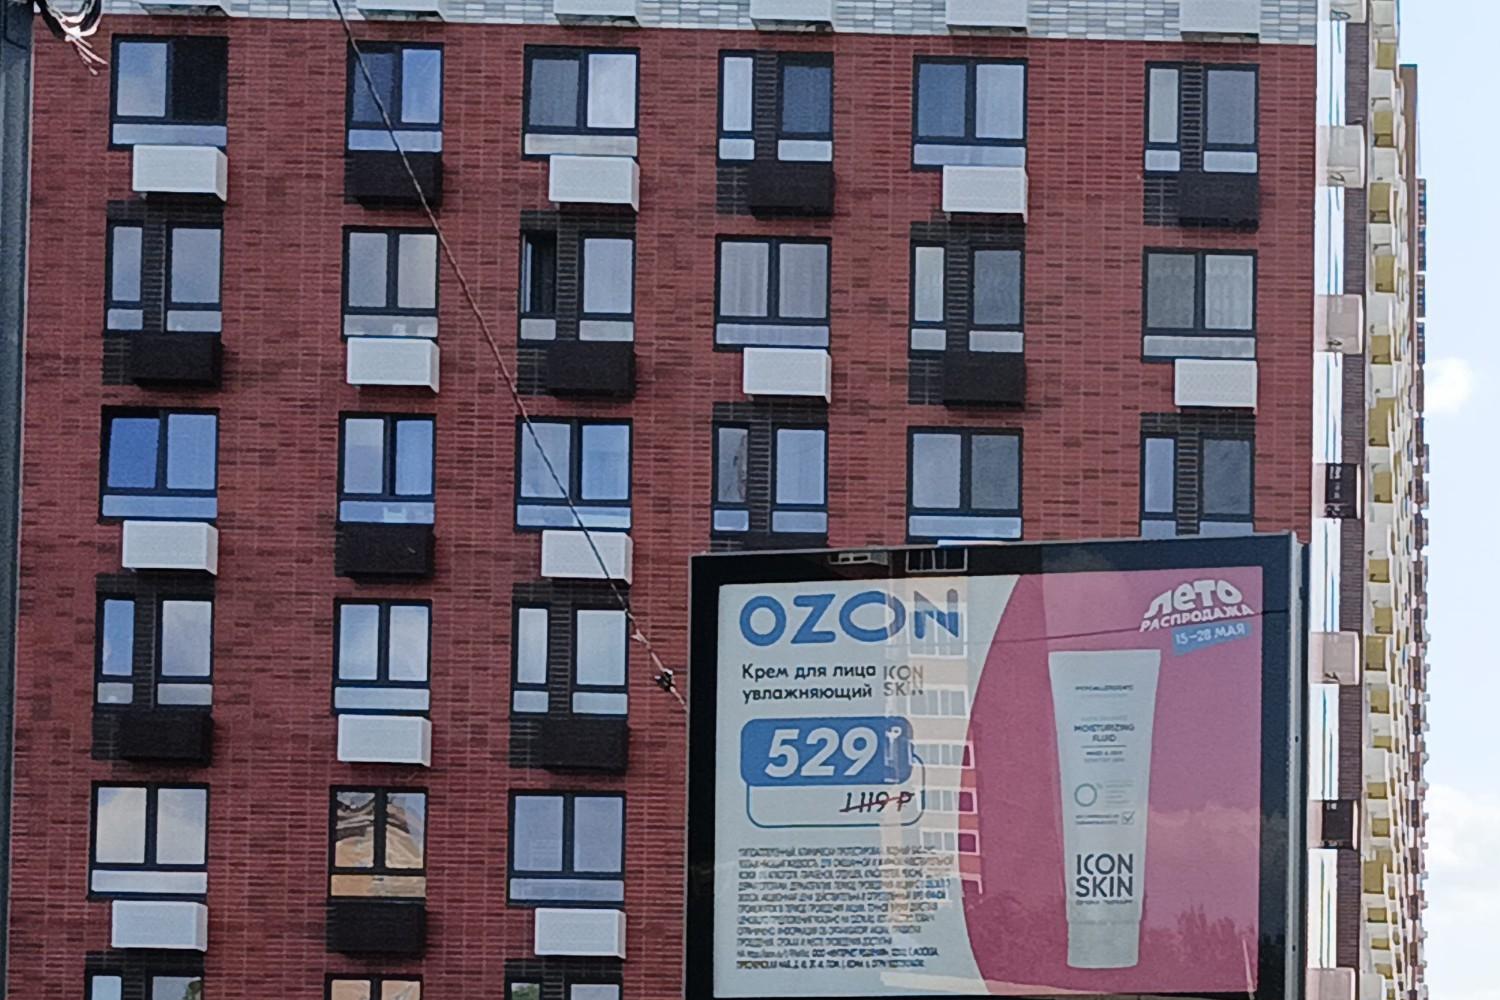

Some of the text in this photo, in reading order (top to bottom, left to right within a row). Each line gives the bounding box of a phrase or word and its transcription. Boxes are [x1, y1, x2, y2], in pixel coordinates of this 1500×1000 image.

[739, 588, 959, 647] OZON
[1139, 604, 1255, 633] РАСПРОДАЖА
[1214, 622, 1246, 639] МАЯ
[741, 663, 877, 682] Крем для лица
[883, 664, 924, 681] ICON
[742, 683, 872, 704] увлажняющий
[764, 726, 879, 778] 529
[1076, 853, 1133, 876] ICON
[1075, 876, 1133, 898] SKIN
